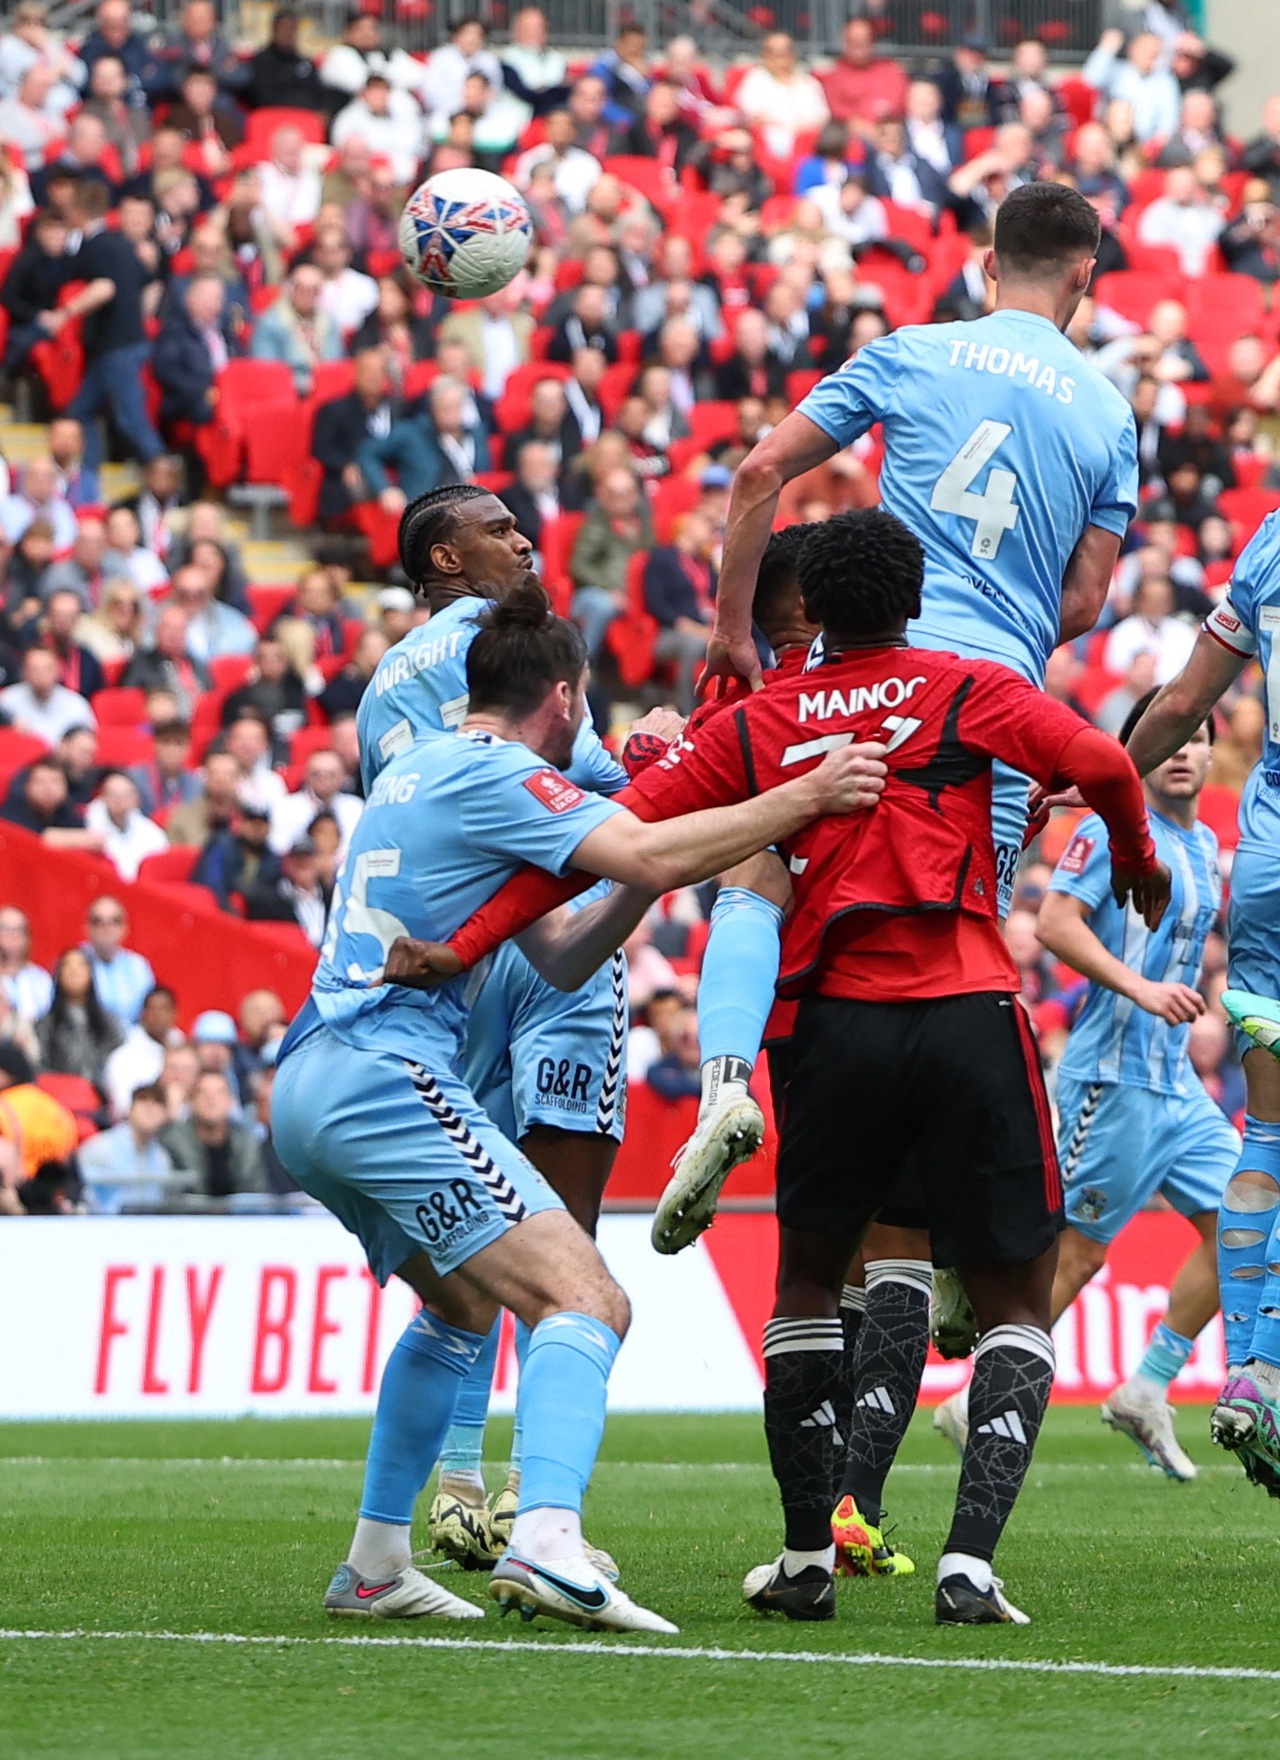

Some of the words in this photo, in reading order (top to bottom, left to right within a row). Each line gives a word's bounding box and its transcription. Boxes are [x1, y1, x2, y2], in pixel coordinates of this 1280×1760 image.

[948, 339, 1077, 405] THOMAS
[930, 419, 1020, 560] 4
[375, 630, 465, 698] WRIGHT
[534, 1093, 588, 1114] SCAFFOLDING
[536, 1057, 592, 1101] G&R
[415, 1178, 483, 1243] G&R
[434, 1211, 490, 1253] SCAFFOLDING
[94, 1265, 224, 1394] FLY
